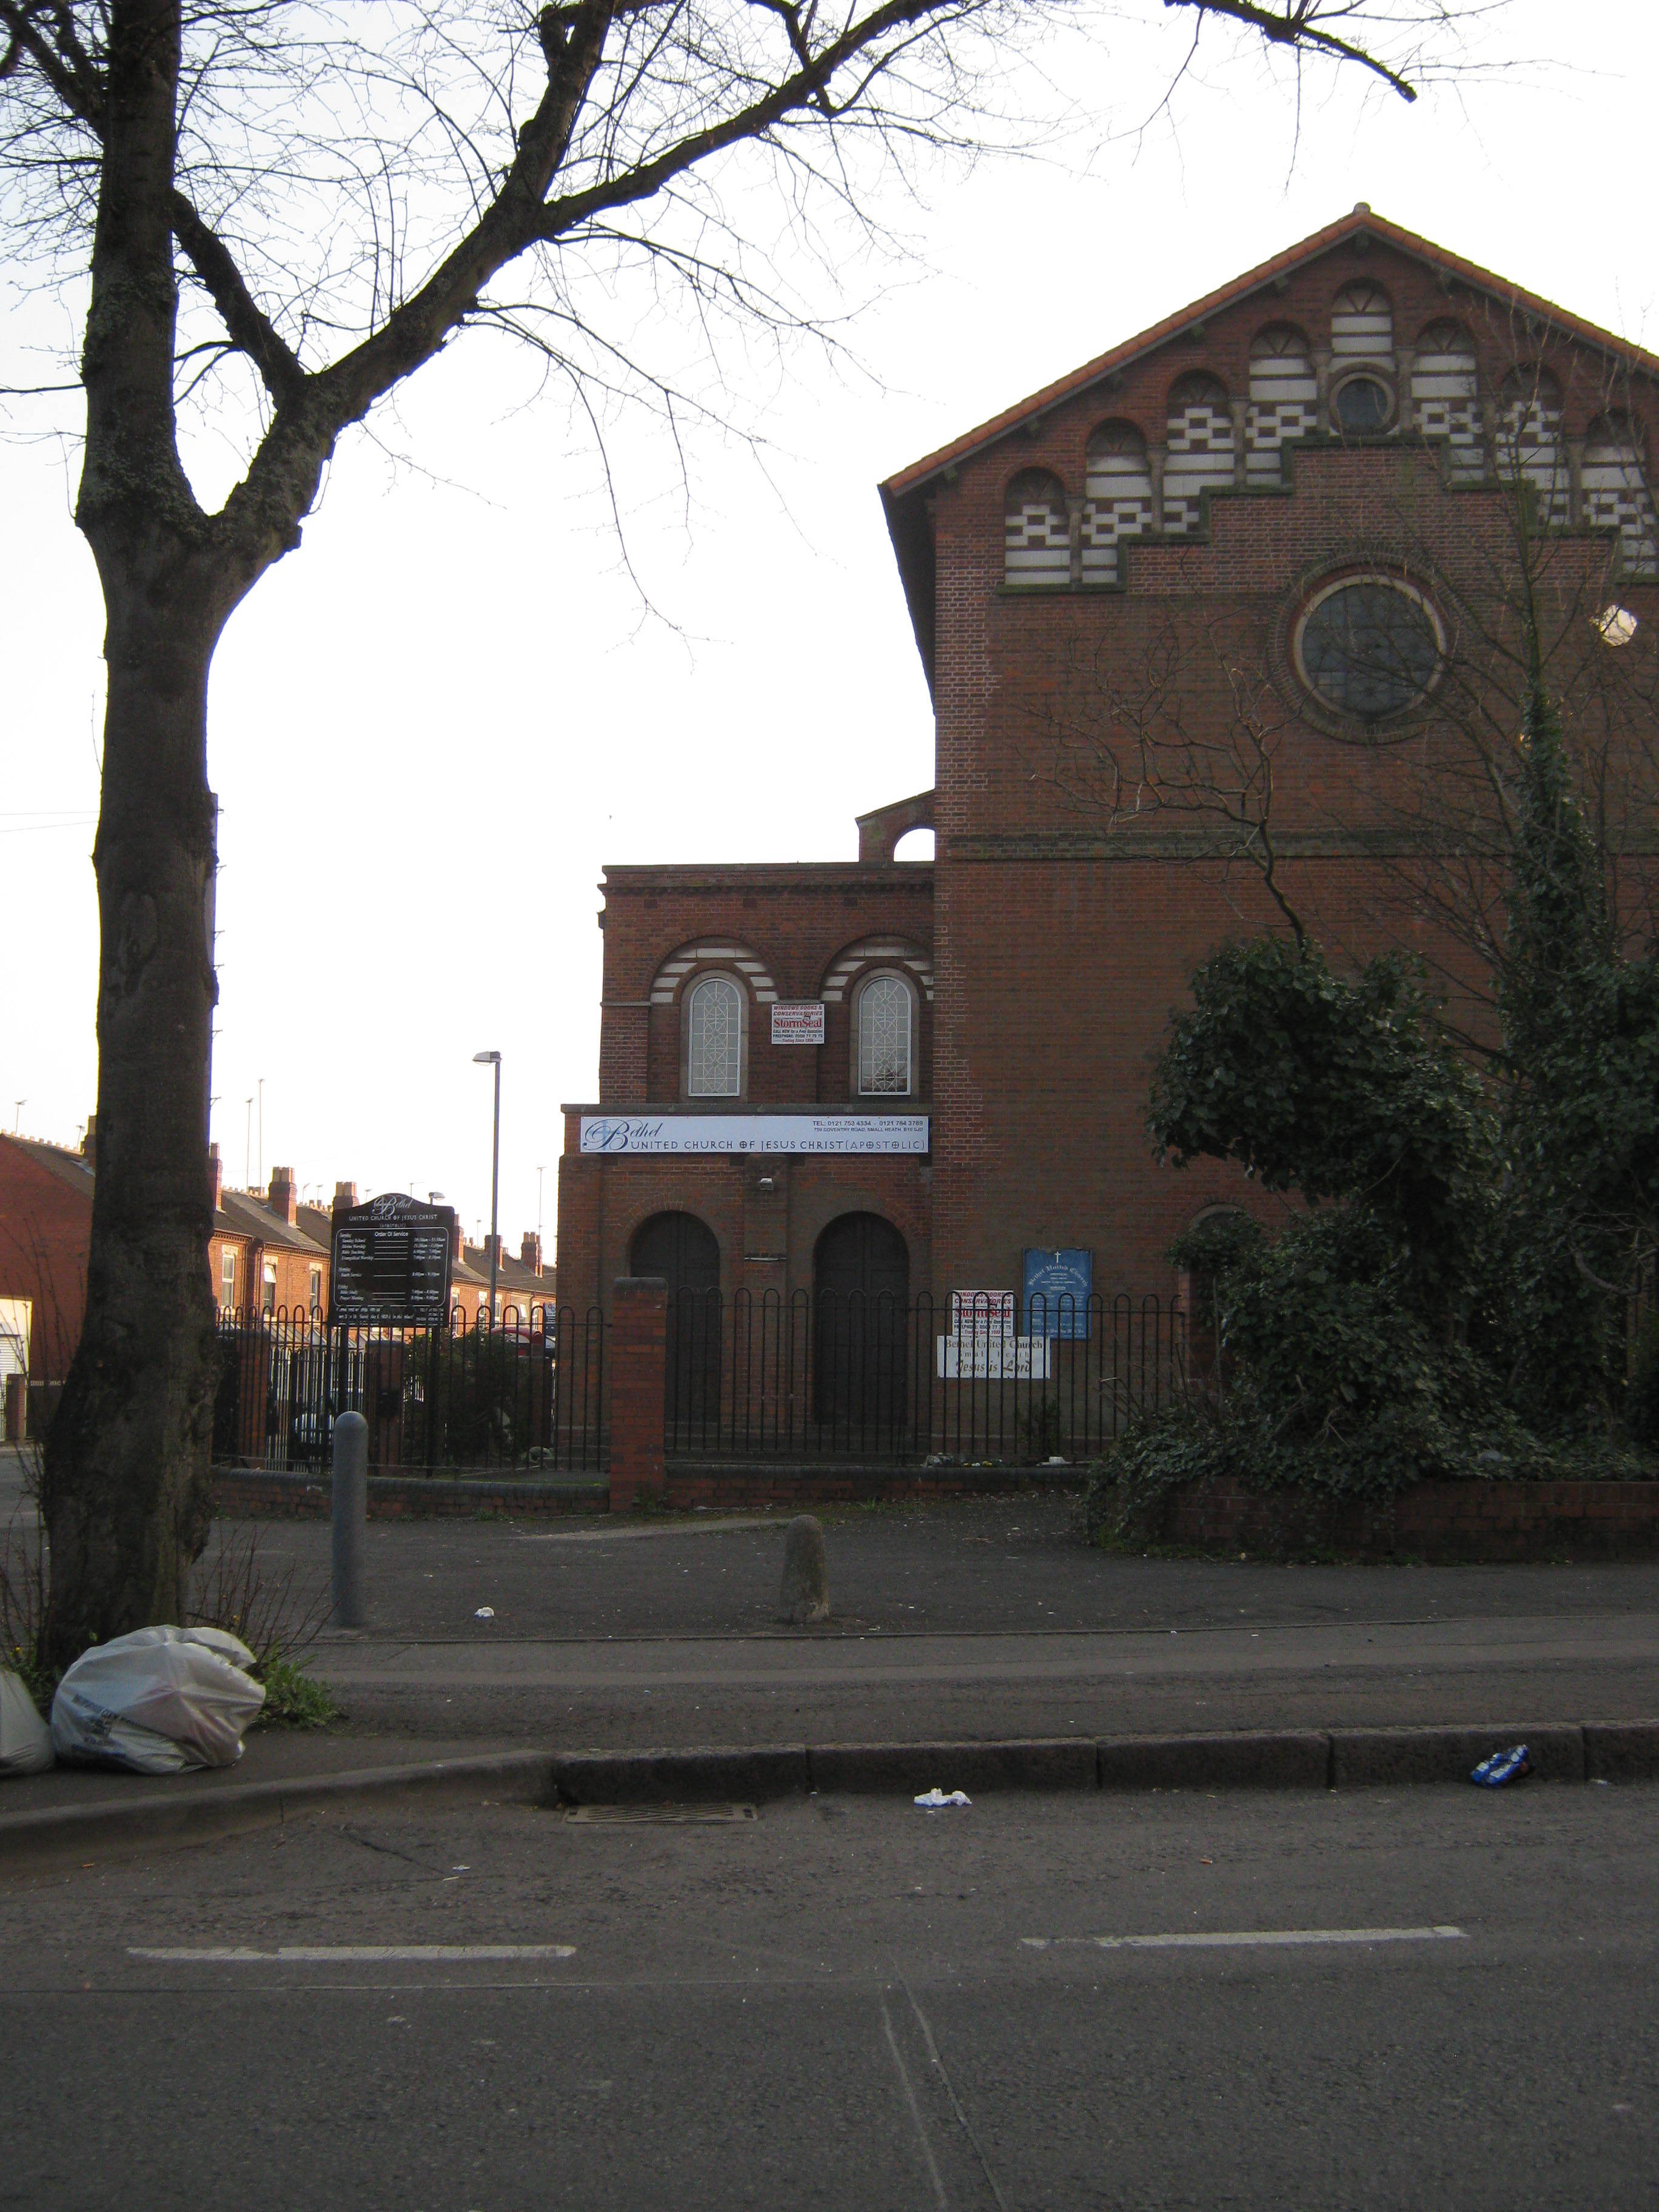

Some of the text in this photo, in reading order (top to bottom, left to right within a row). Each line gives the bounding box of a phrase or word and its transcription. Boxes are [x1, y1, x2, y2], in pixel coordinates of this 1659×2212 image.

[774, 1019, 822, 1028] StormSeal
[582, 1119, 664, 1150] Bethel
[631, 1141, 925, 1151] UNITED CHURCH OF JESUS CHRIST (APOSTOLIC)
[372, 1195, 414, 1216] Bethel
[988, 1360, 997, 1372] is
